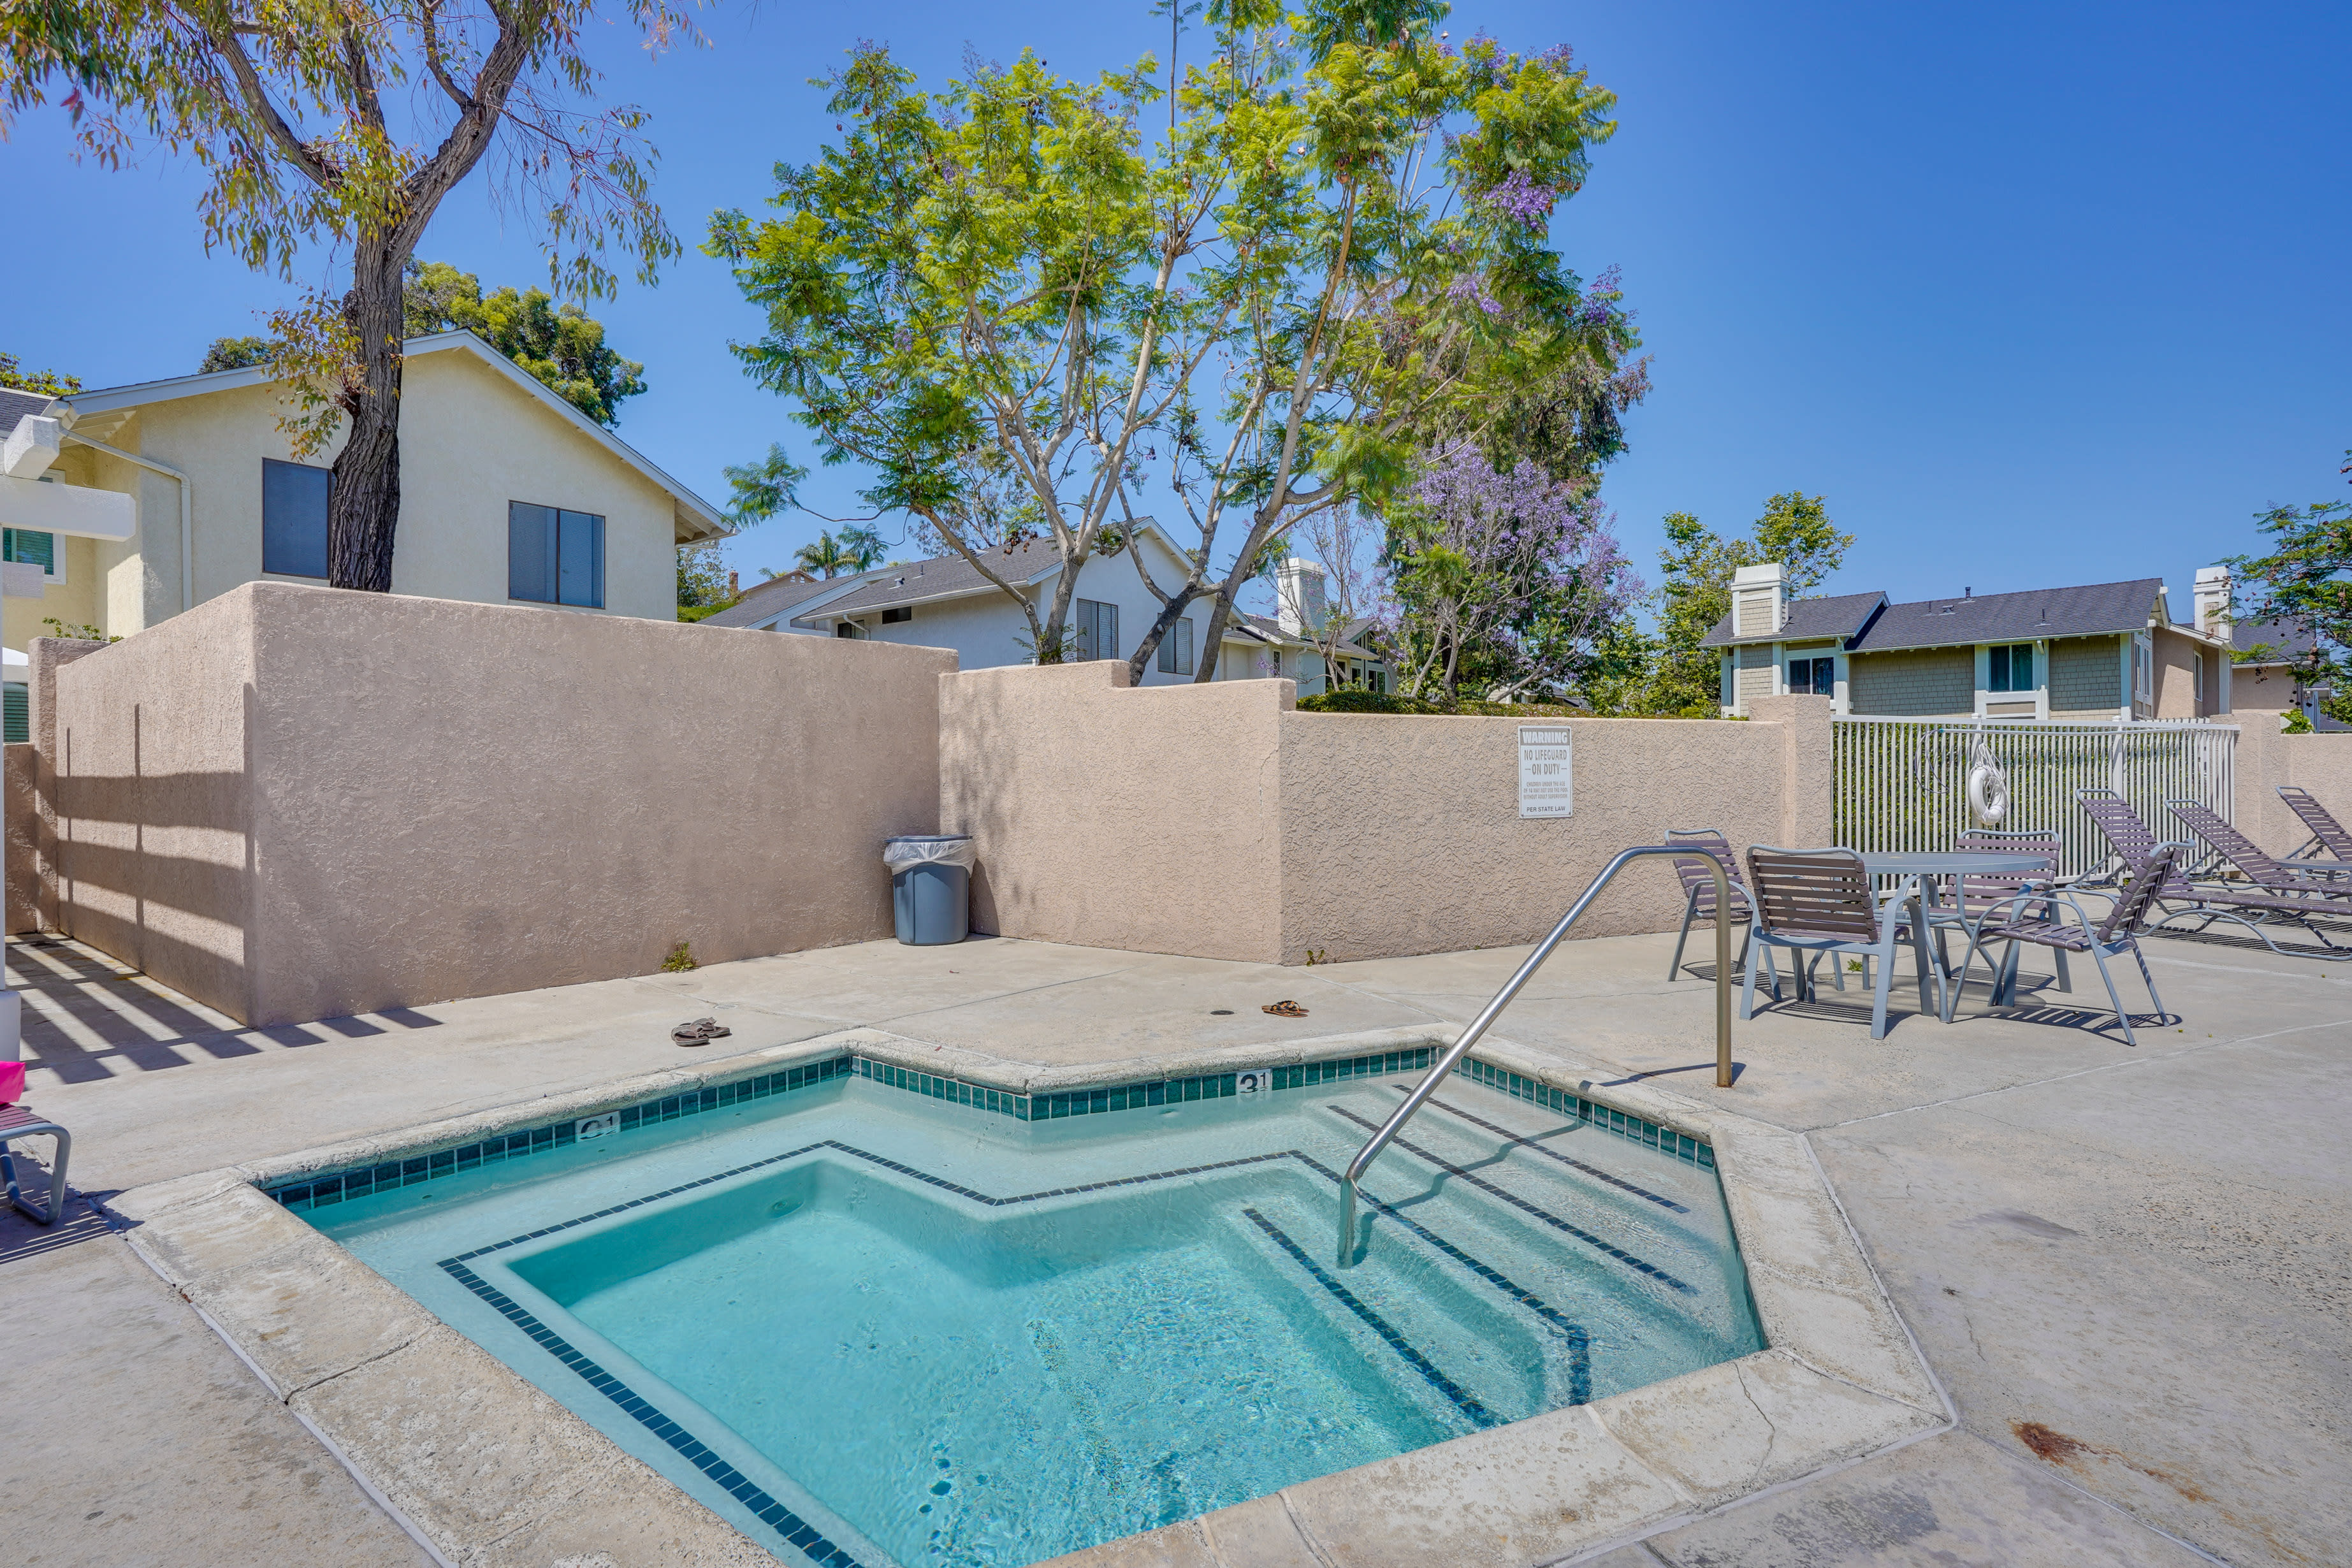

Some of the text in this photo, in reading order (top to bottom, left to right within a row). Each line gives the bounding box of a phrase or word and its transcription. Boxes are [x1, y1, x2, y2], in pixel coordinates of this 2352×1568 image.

[1522, 731, 1568, 744] WARNING
[1524, 749, 1567, 760] NO LIFEGUARD
[1532, 763, 1560, 776] ON DUTY
